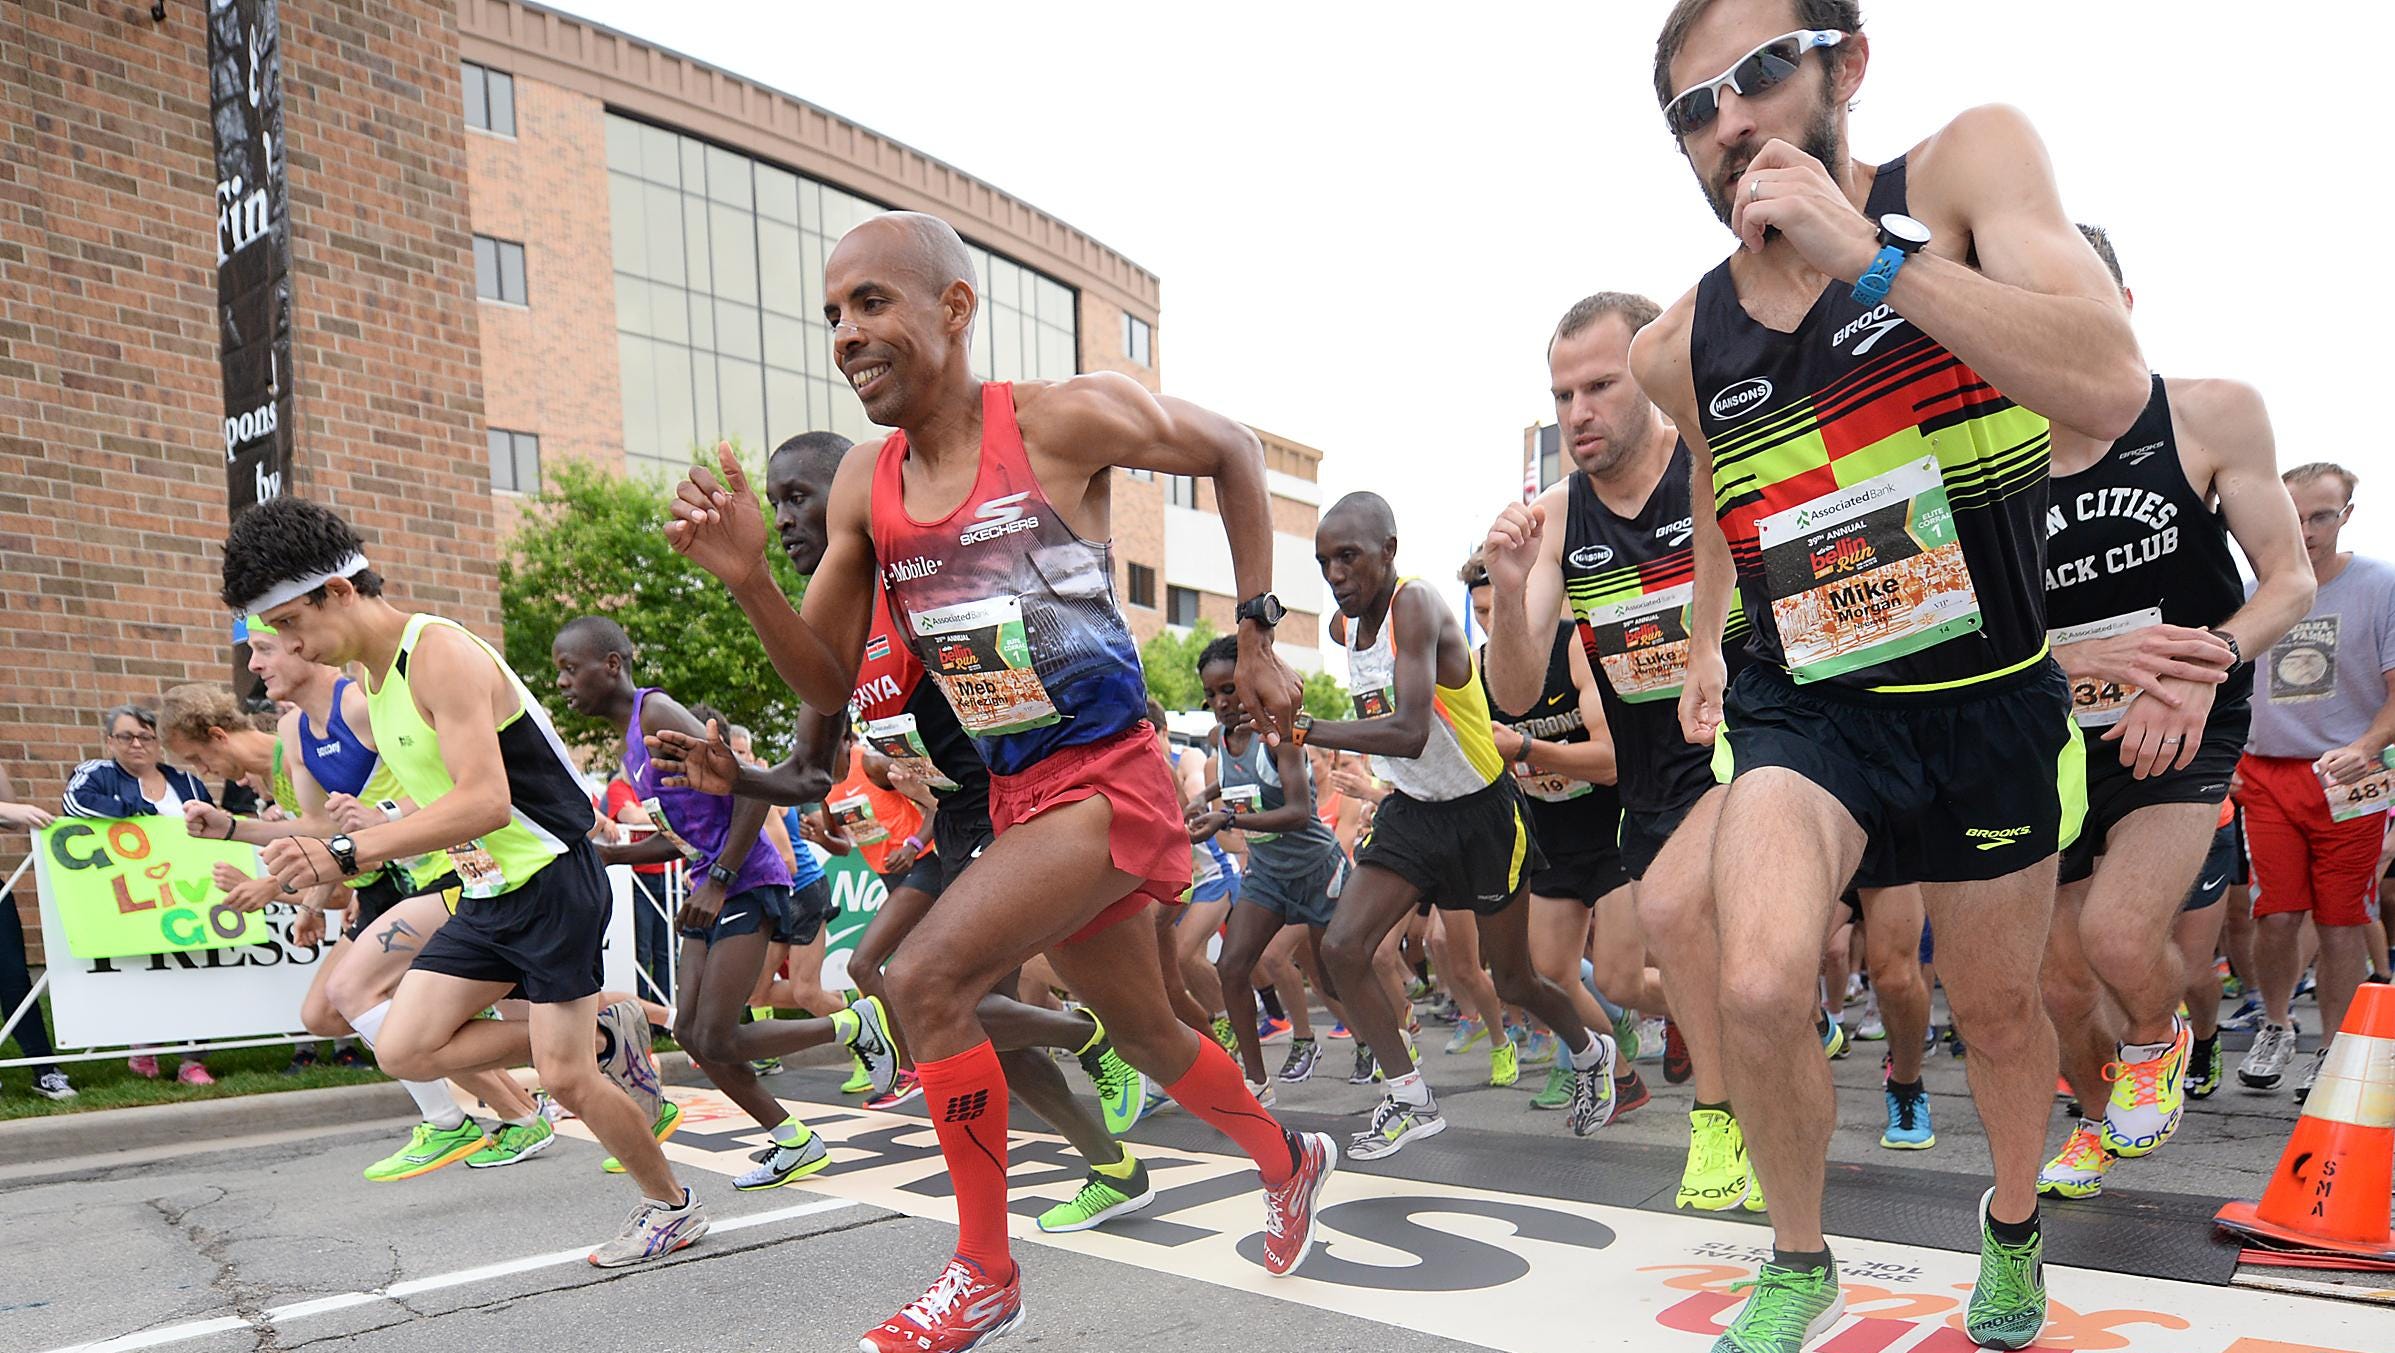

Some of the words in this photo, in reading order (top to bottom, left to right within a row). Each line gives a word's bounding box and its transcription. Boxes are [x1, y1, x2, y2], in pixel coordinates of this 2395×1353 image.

[1832, 303, 1895, 347] BROO
[1714, 385, 1767, 412] HANSONS
[2118, 441, 2164, 460] BROOKS
[1922, 507, 1944, 520] ELITE
[2076, 487, 2178, 530] CITIES
[959, 516, 1039, 546] SKECHERS
[1656, 517, 1692, 539] BROO
[1826, 520, 1867, 541] ANNUAL
[1918, 512, 1951, 529] CORRAL
[1931, 524, 1942, 538] 1
[1809, 537, 1867, 572] bellin
[1836, 546, 1876, 573] Run
[2105, 526, 2179, 574] CLUB
[1829, 578, 1899, 611] Mike
[1838, 597, 1901, 622] Morgan
[1940, 626, 1950, 634] 14
[938, 644, 974, 664] bellin
[1013, 650, 1020, 662] 1
[1635, 650, 1676, 667] Luke
[957, 680, 996, 697] Meb
[2074, 682, 2124, 705] 34
[1541, 780, 1563, 792] 19
[2348, 779, 2391, 803] 481
[1965, 826, 2031, 838] BROOKS
[50, 821, 151, 870] GO
[160, 904, 246, 946] GO
[2103, 1109, 2178, 1149] ROOKS
